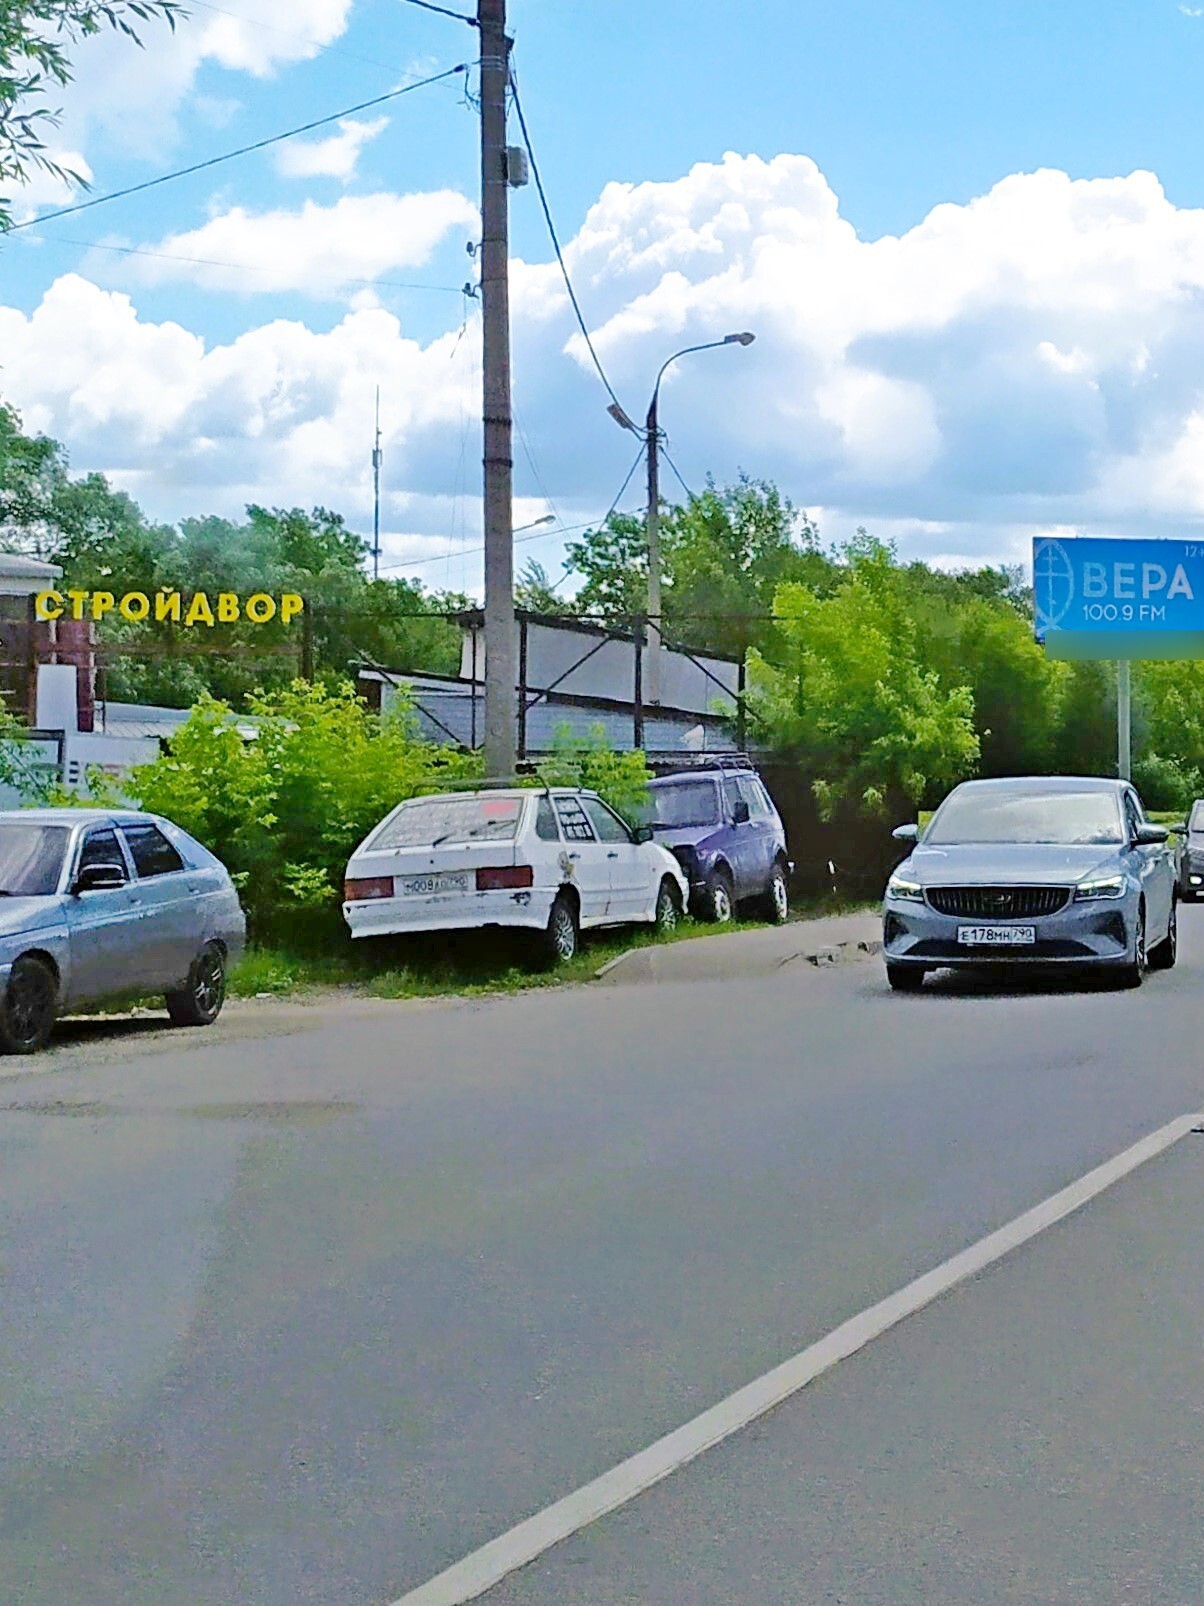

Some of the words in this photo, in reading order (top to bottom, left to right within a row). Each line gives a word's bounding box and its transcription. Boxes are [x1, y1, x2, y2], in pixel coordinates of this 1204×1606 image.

[1083, 562, 1194, 600] ВЕРА
[36, 587, 304, 627] СТРОЙДВОР
[1083, 604, 1134, 621] 100.9
[1139, 605, 1165, 621] FM
